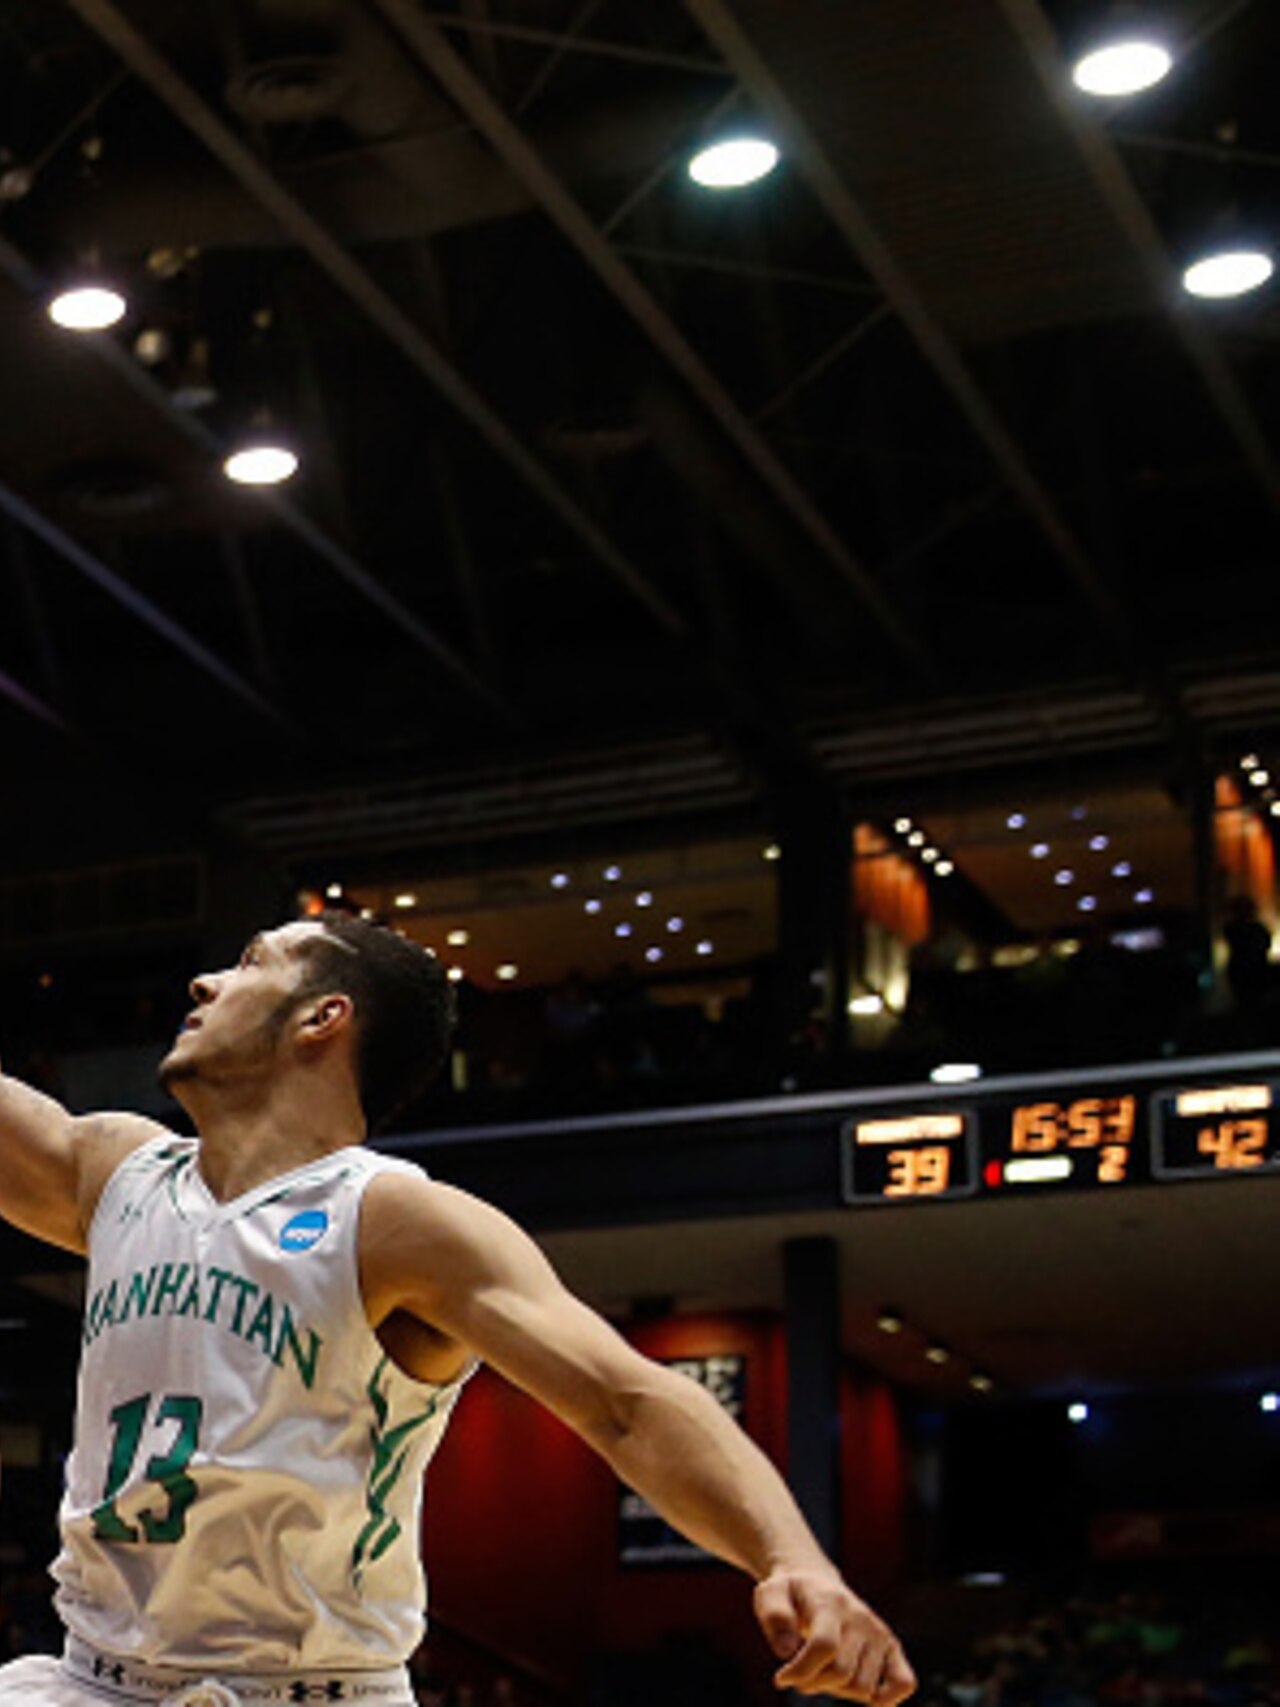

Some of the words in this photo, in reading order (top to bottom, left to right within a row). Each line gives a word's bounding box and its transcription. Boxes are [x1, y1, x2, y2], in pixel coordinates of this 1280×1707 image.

[1197, 1117, 1269, 1169] 42
[883, 1145, 950, 1198] 39
[90, 1392, 204, 1544] 13
